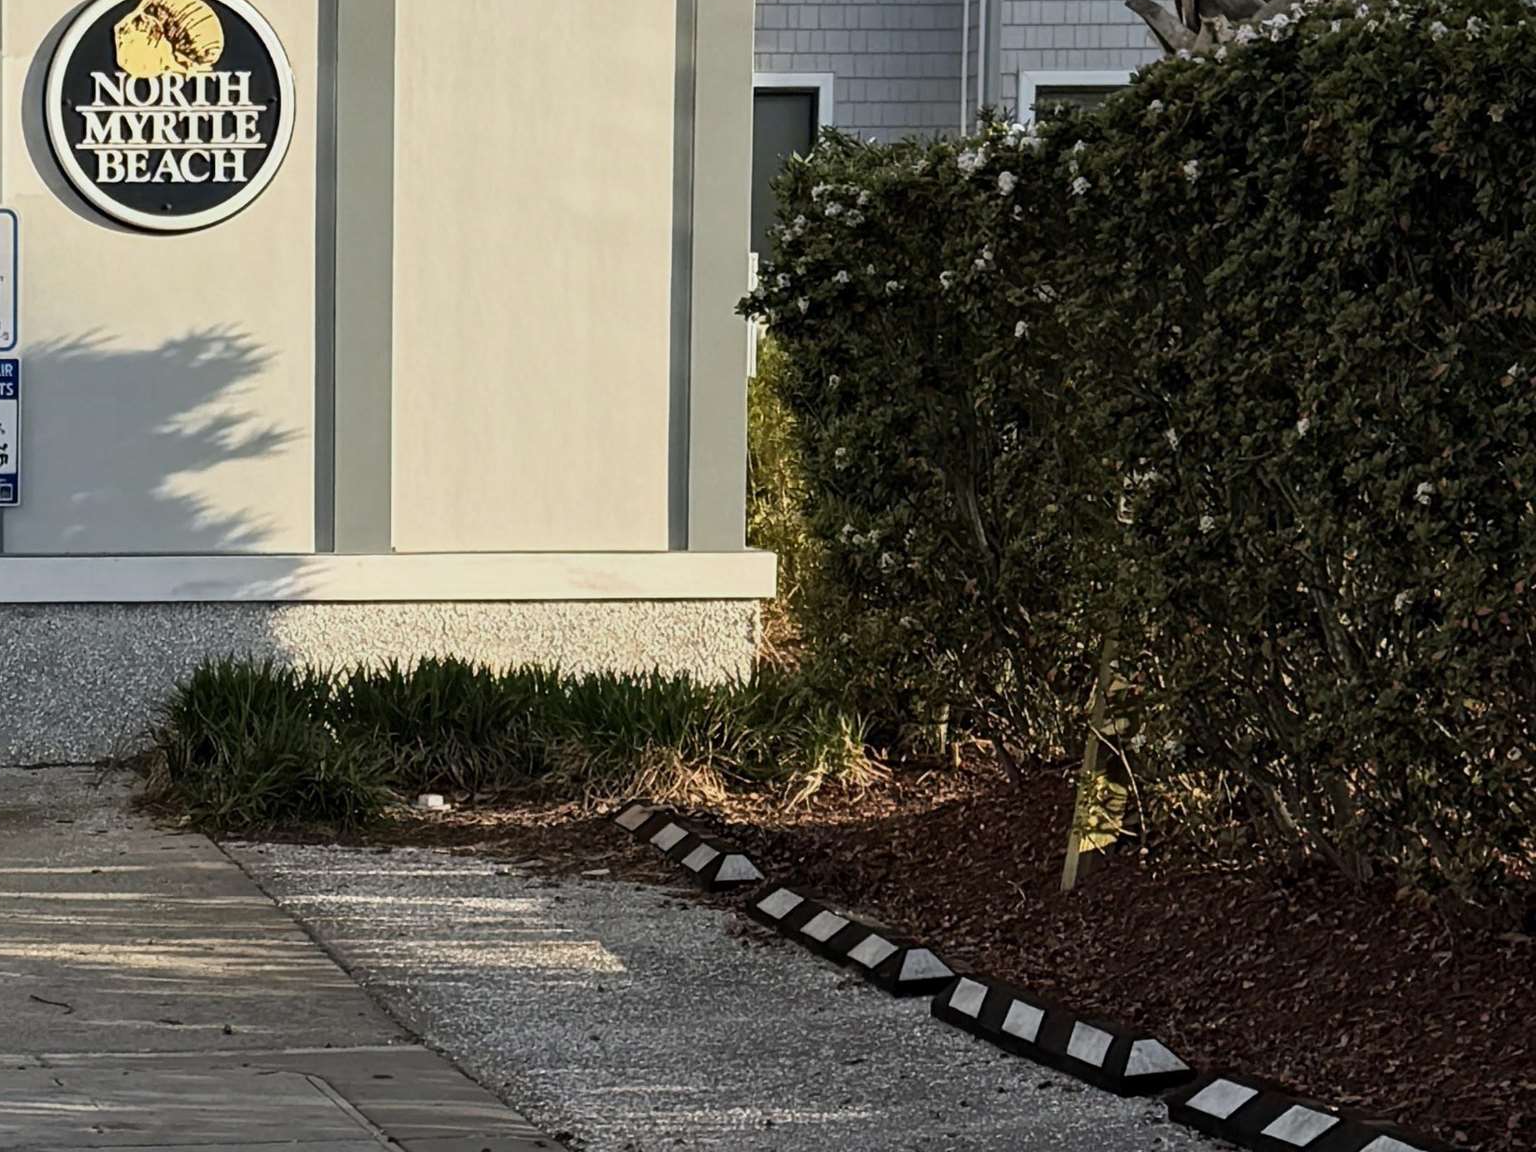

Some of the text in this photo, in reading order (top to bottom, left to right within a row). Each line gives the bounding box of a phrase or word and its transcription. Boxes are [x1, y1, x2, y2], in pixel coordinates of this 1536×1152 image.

[90, 71, 252, 107] NORTH
[82, 111, 261, 144] MYRTLE
[94, 149, 248, 183] BEACH
